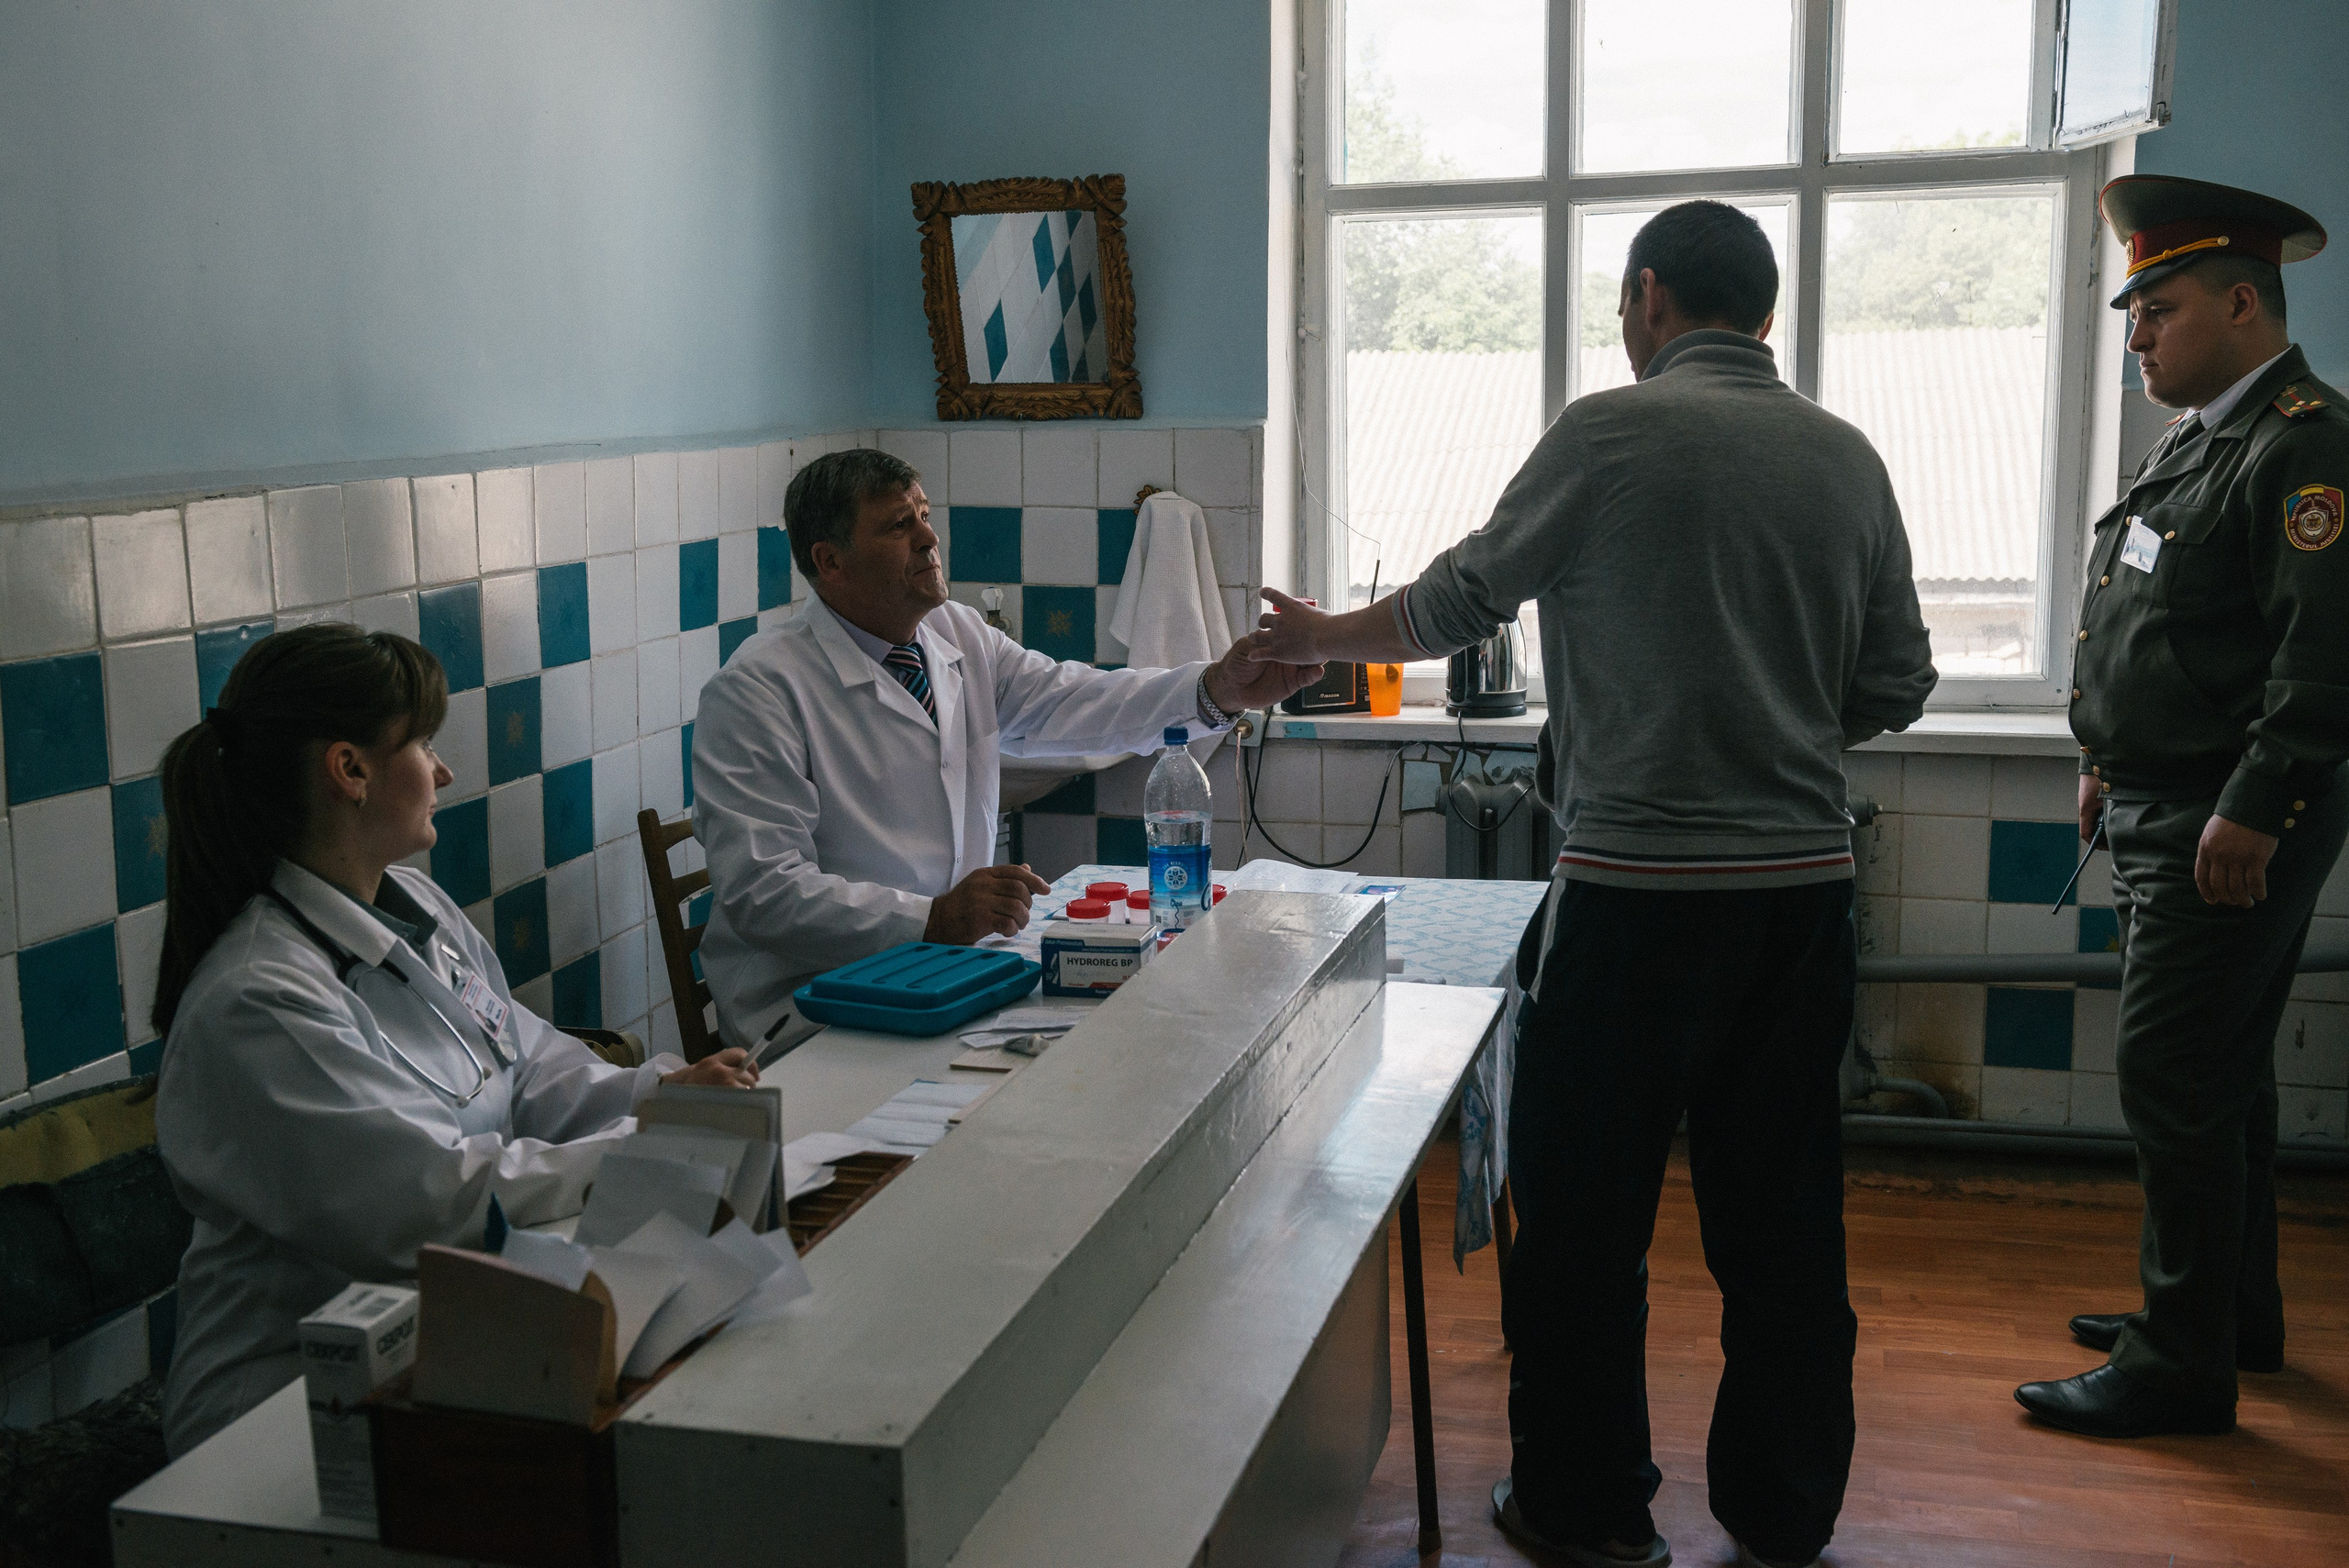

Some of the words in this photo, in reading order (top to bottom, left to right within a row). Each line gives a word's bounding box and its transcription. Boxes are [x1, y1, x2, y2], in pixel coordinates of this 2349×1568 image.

[2314, 495, 2338, 517] MOLDOVA
[2290, 528, 2318, 549] MINISTERUL
[1066, 957, 1119, 966] HYDROREG
[1120, 959, 1133, 967] BP
